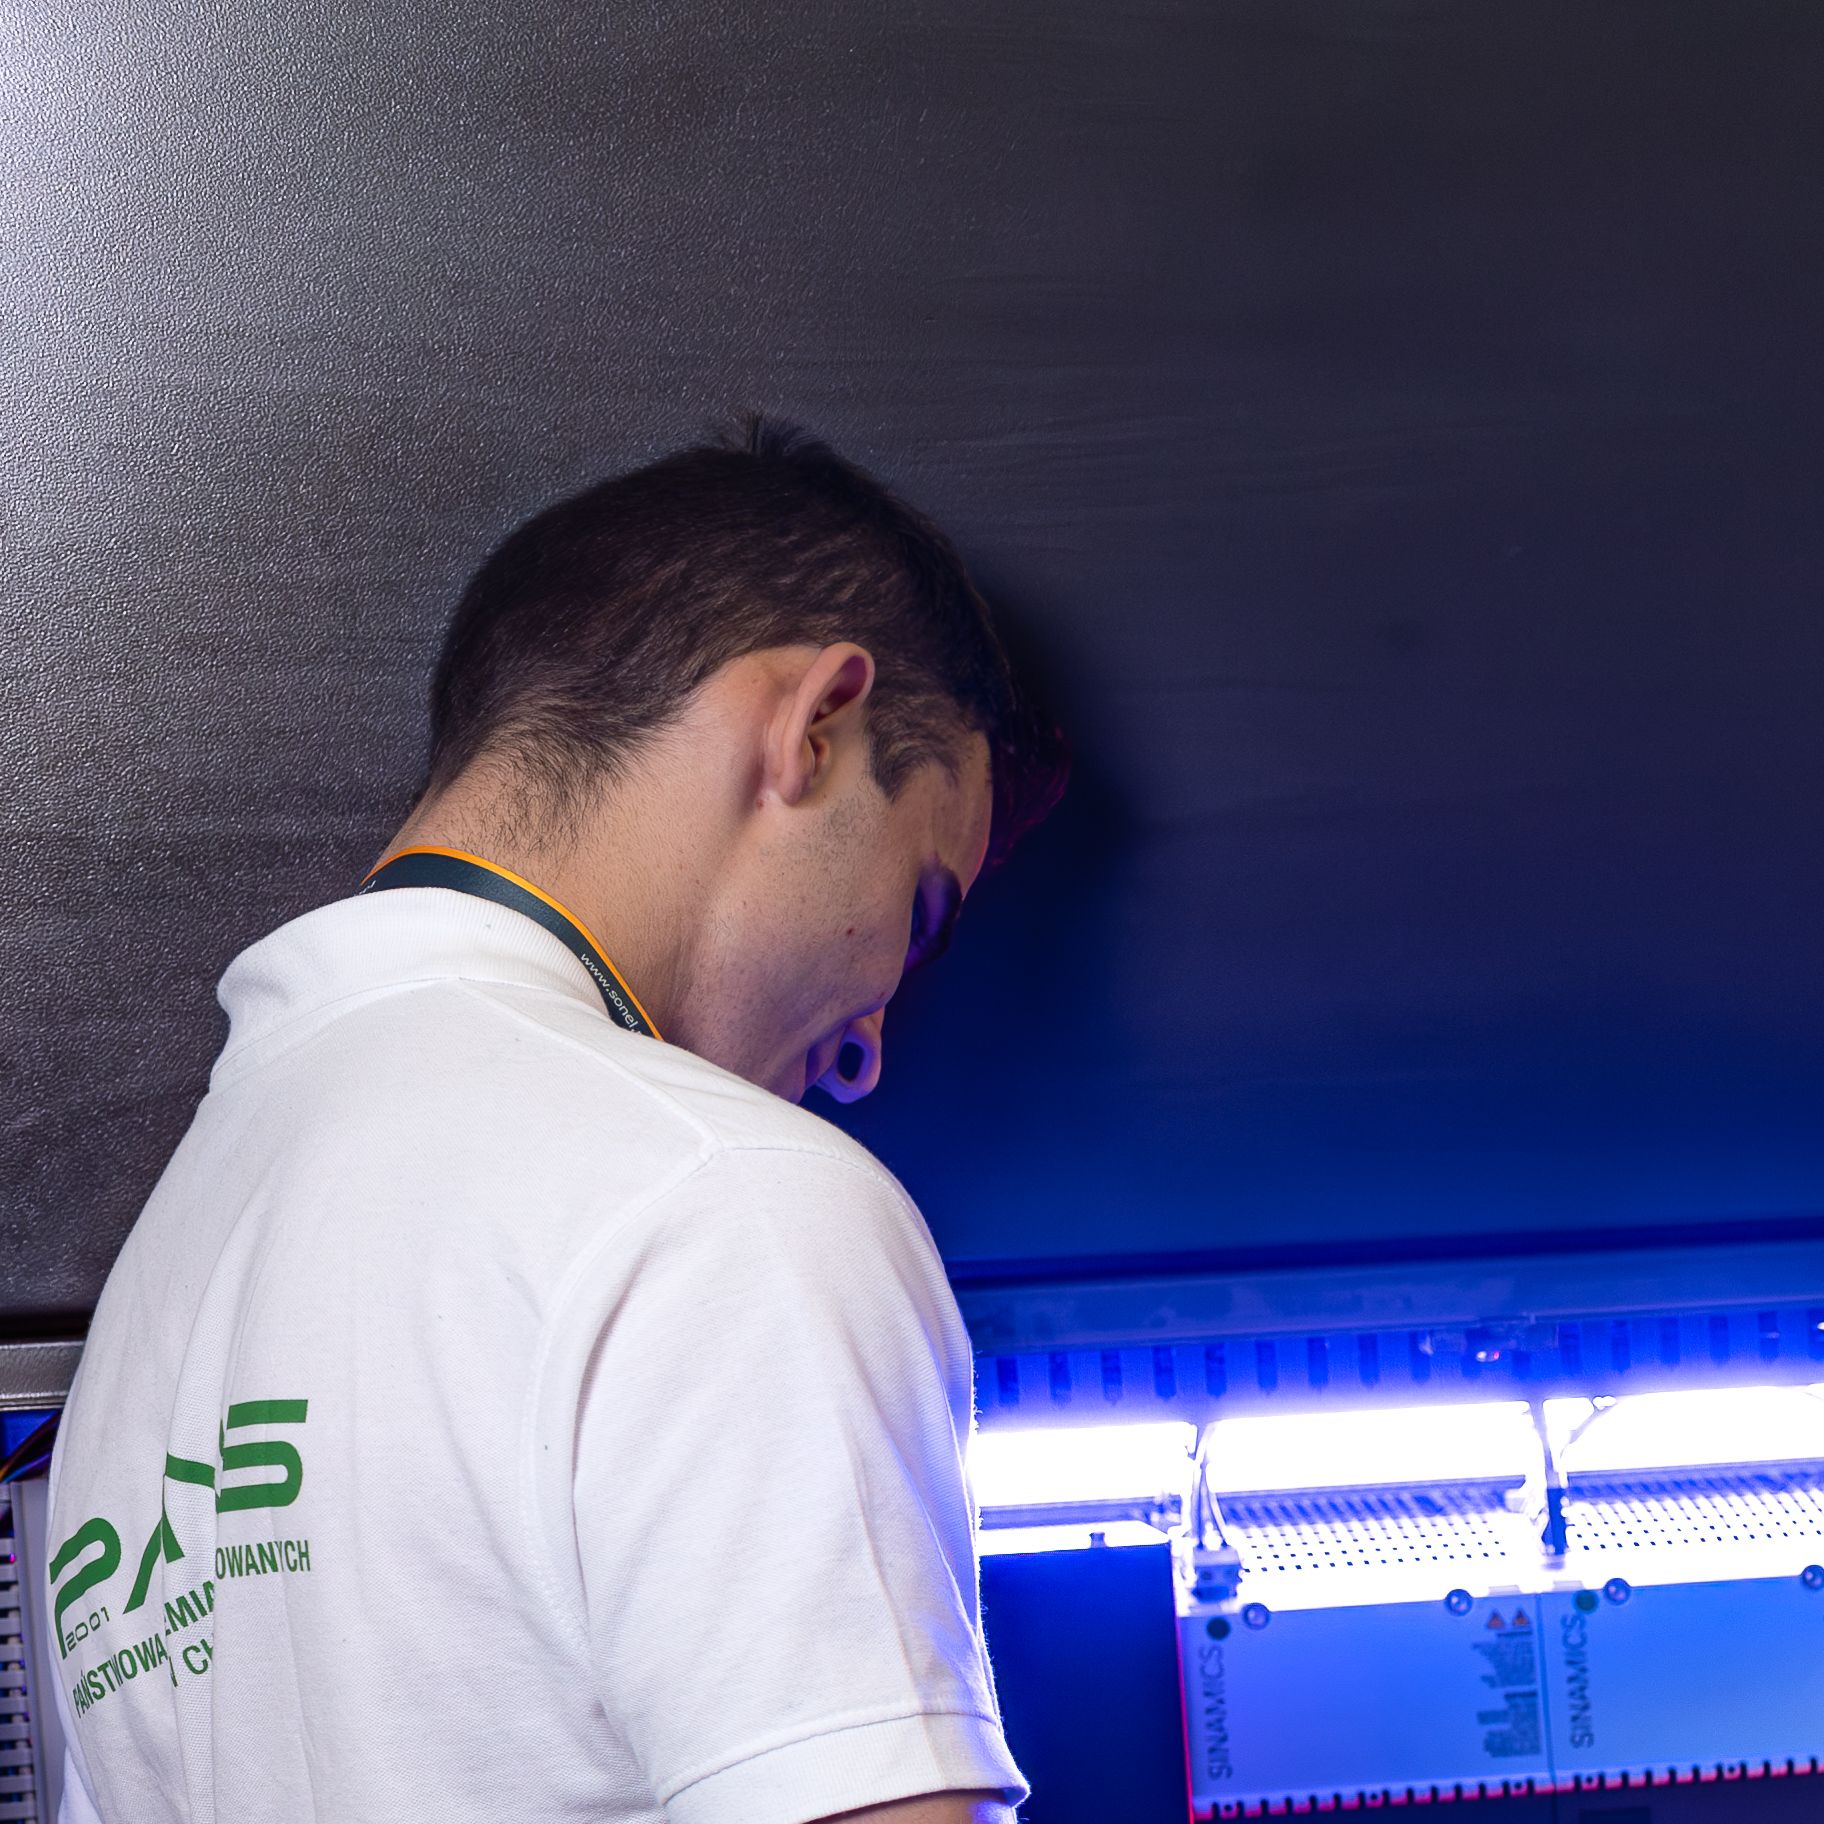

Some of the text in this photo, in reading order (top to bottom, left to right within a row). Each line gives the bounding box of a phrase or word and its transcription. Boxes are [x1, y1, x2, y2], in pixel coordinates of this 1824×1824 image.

[215, 1539, 311, 1580] OWANYCH
[66, 1607, 110, 1652] 2001
[1206, 1645, 1233, 1780] SINAMICS
[1569, 1612, 1596, 1750] SINAMICS
